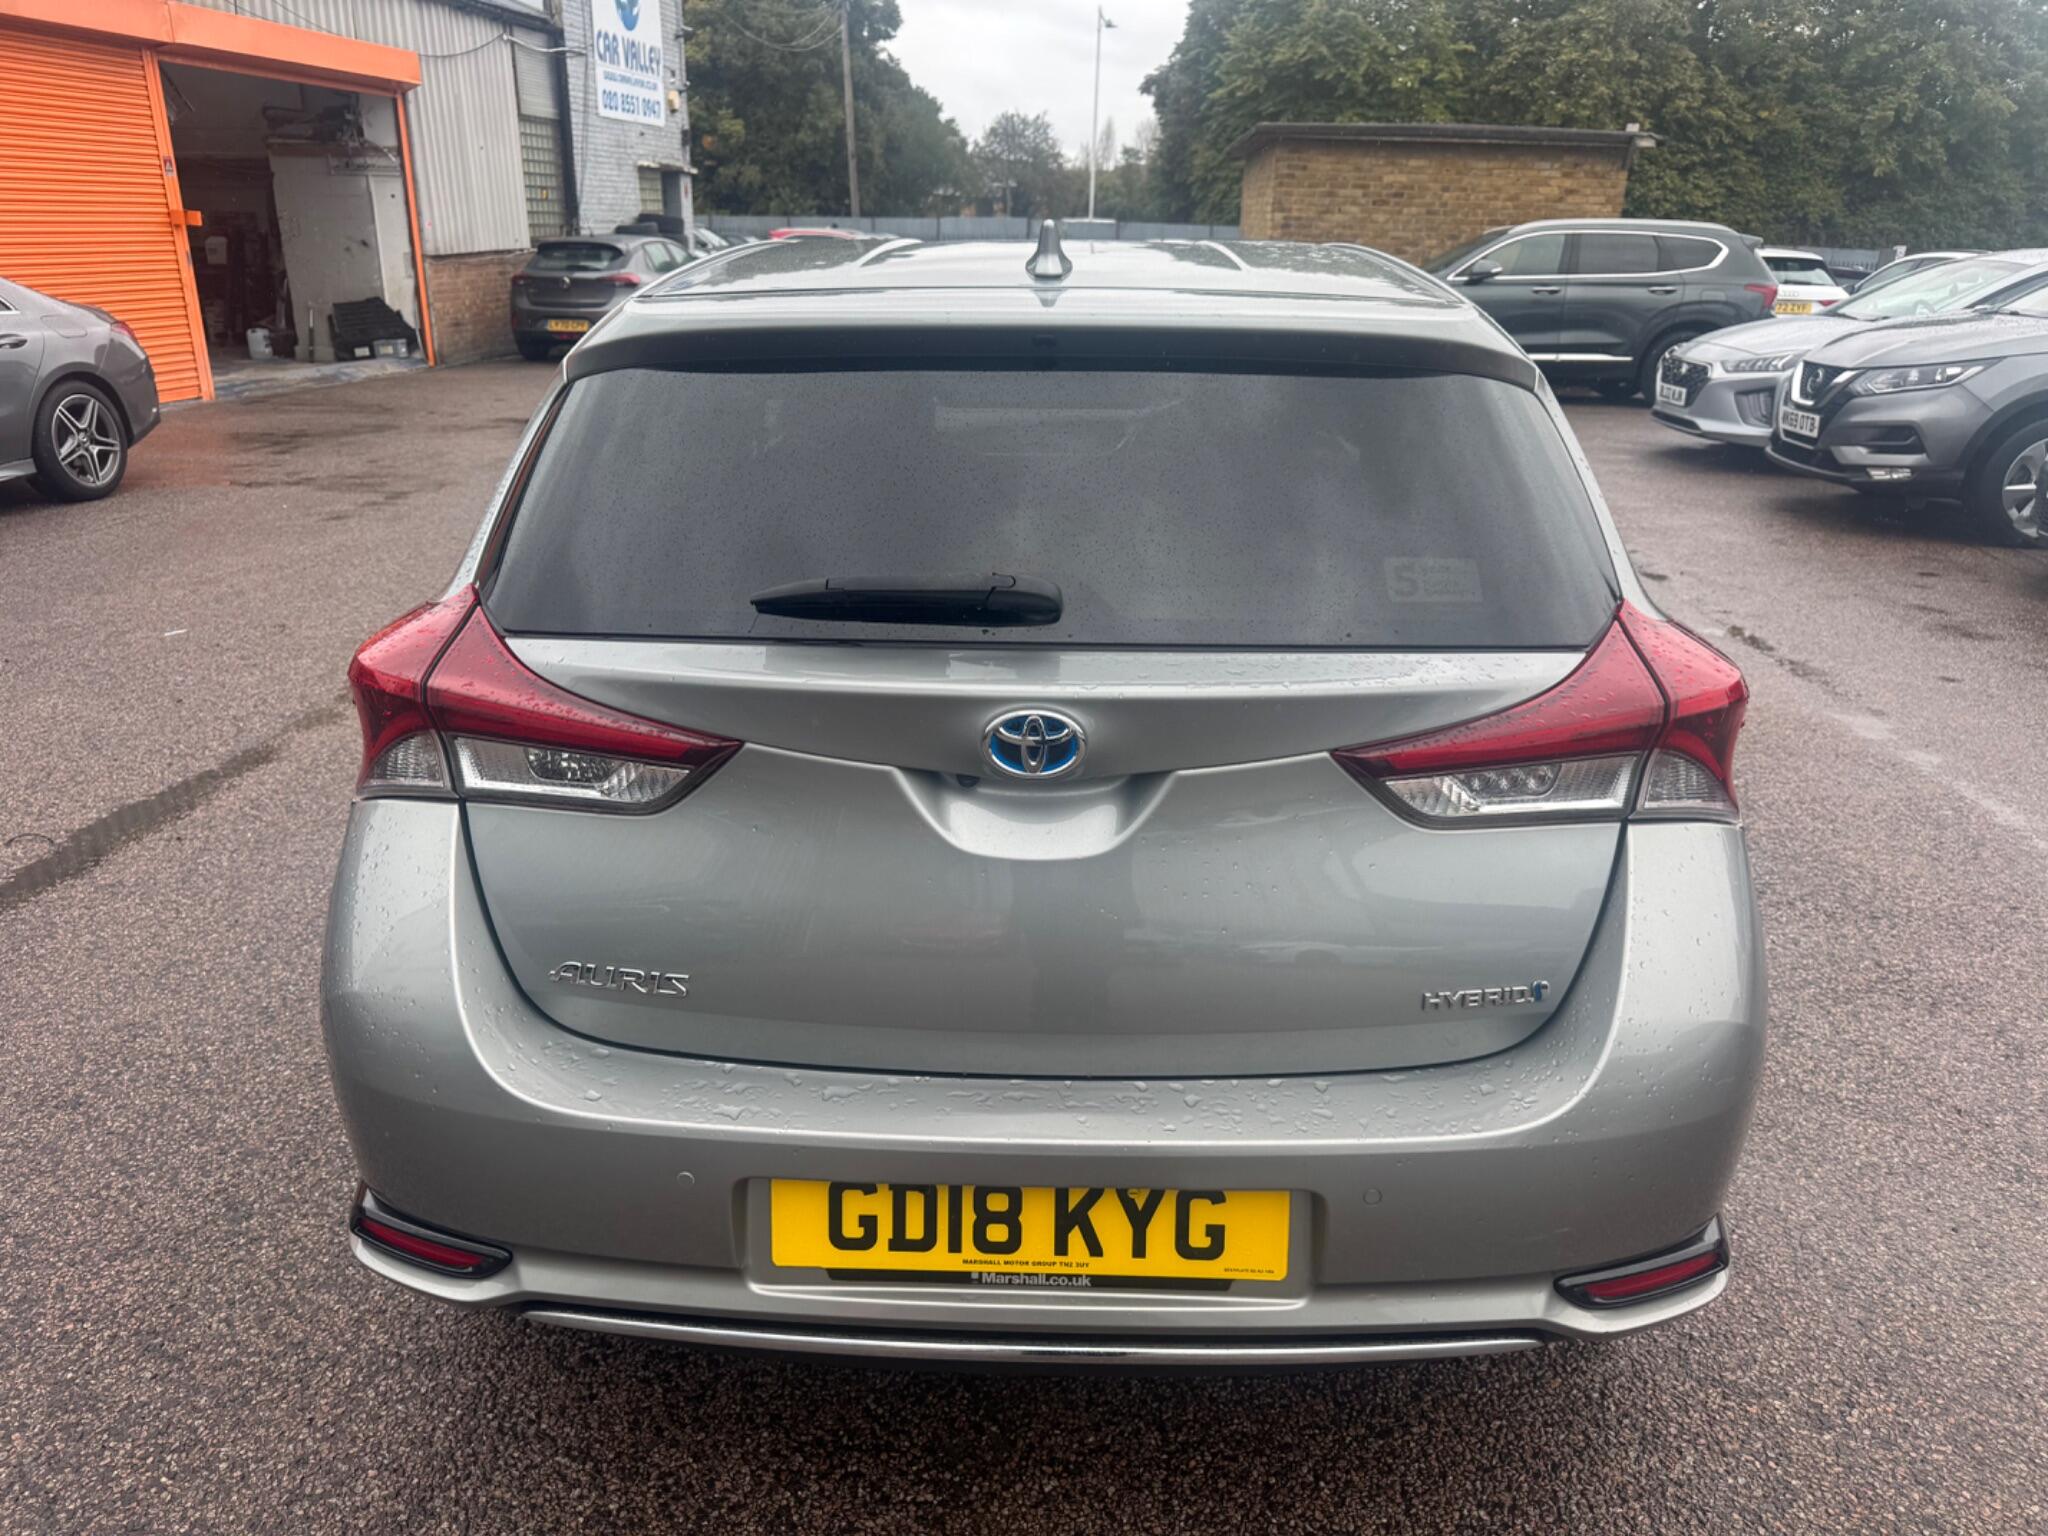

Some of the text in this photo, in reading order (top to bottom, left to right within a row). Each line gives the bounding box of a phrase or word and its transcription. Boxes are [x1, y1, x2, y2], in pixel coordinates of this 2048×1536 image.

[596, 30, 661, 77] CAR VALLEY
[602, 88, 619, 112] 020
[548, 961, 689, 996] AURIS
[1421, 985, 1529, 1011] HYBRID
[828, 1182, 1228, 1261] GD18 KYG
[962, 1258, 1001, 1266] MARSHALL
[981, 1272, 1092, 1287] Marshall.co.uk
